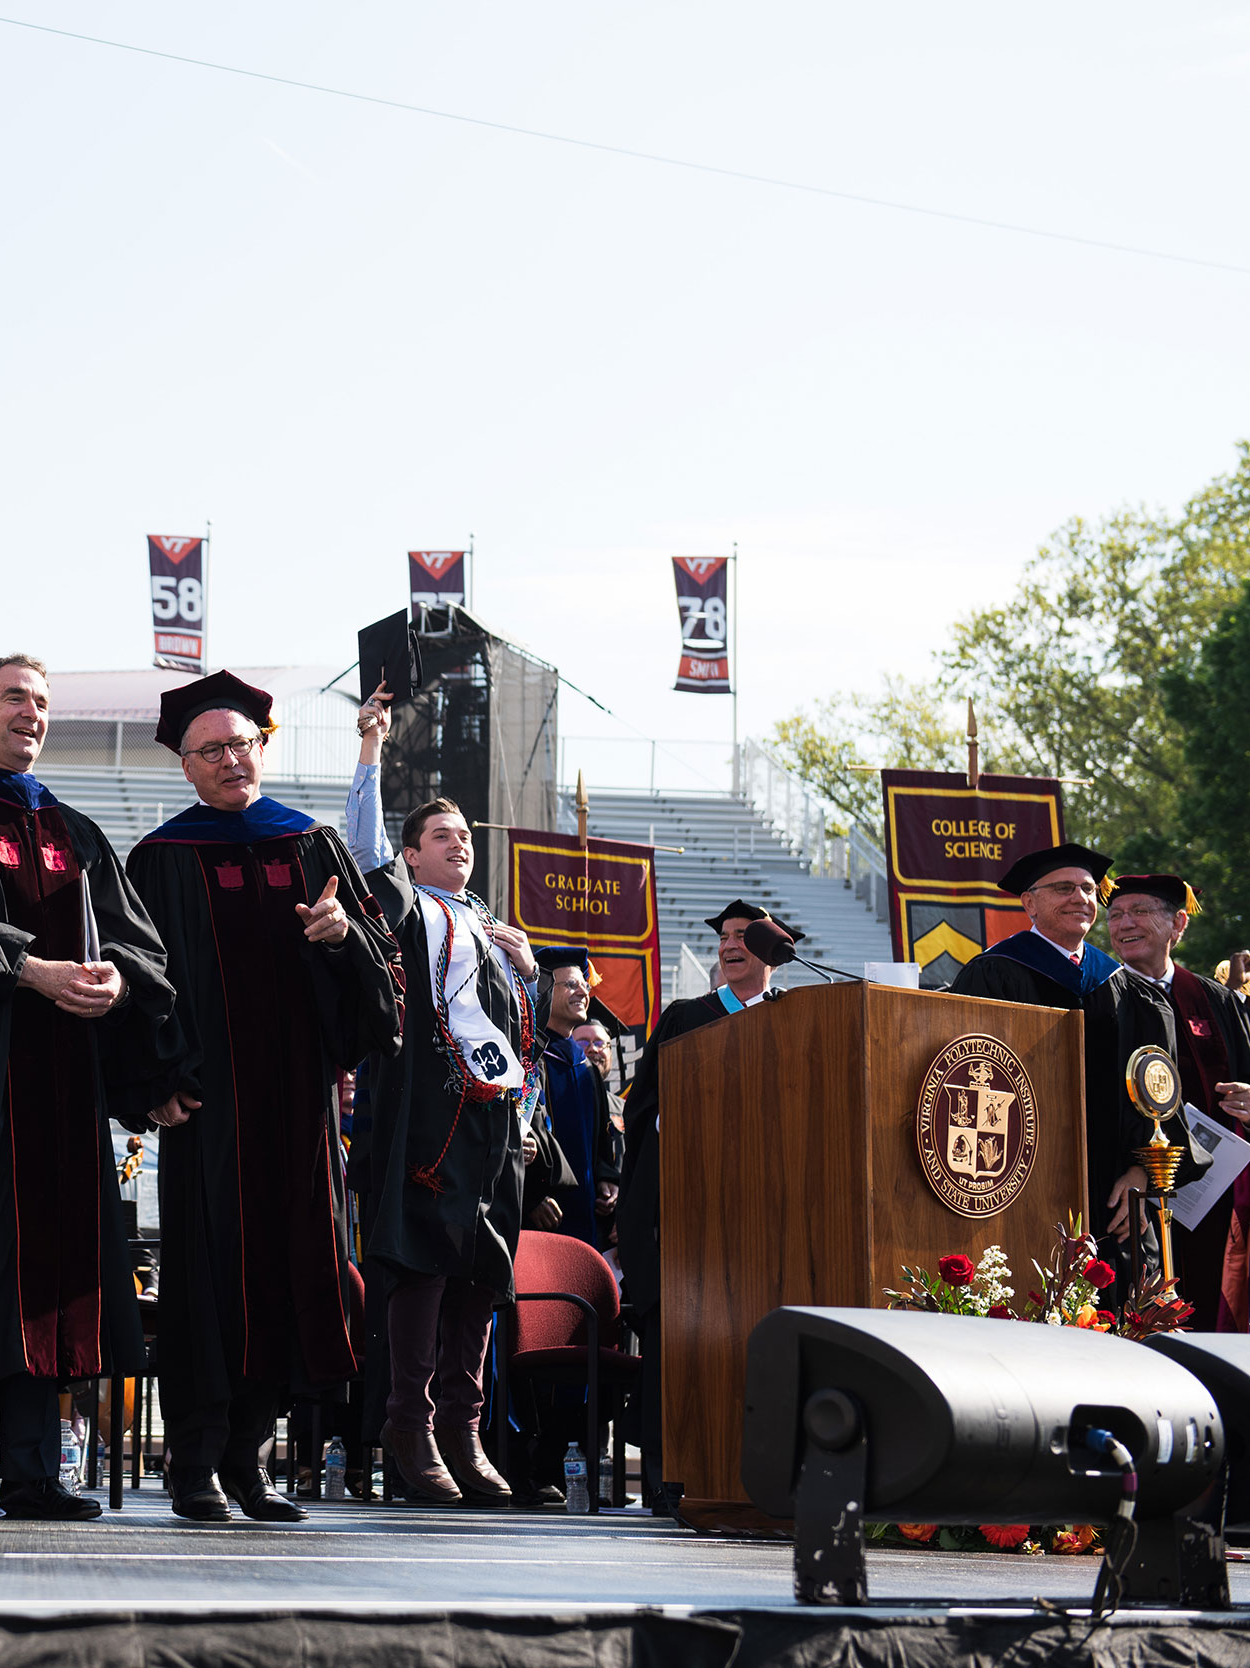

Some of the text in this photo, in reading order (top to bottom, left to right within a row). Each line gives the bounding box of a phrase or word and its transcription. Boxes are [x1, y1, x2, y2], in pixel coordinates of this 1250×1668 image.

[160, 536, 191, 553] VT
[421, 552, 452, 569] VT
[685, 558, 716, 574] VT
[151, 575, 202, 622] 58
[677, 596, 726, 641] 78
[158, 635, 198, 655] BROWN
[931, 819, 1016, 839] COLLEGE OF
[944, 842, 1002, 860] SCIENCE
[921, 1040, 1036, 1147] VIRGINIA POLYTECHNIC INSTITUTE
[924, 1148, 1031, 1211] AND STATE UNIVERSITY
[958, 1177, 967, 1186] UT
